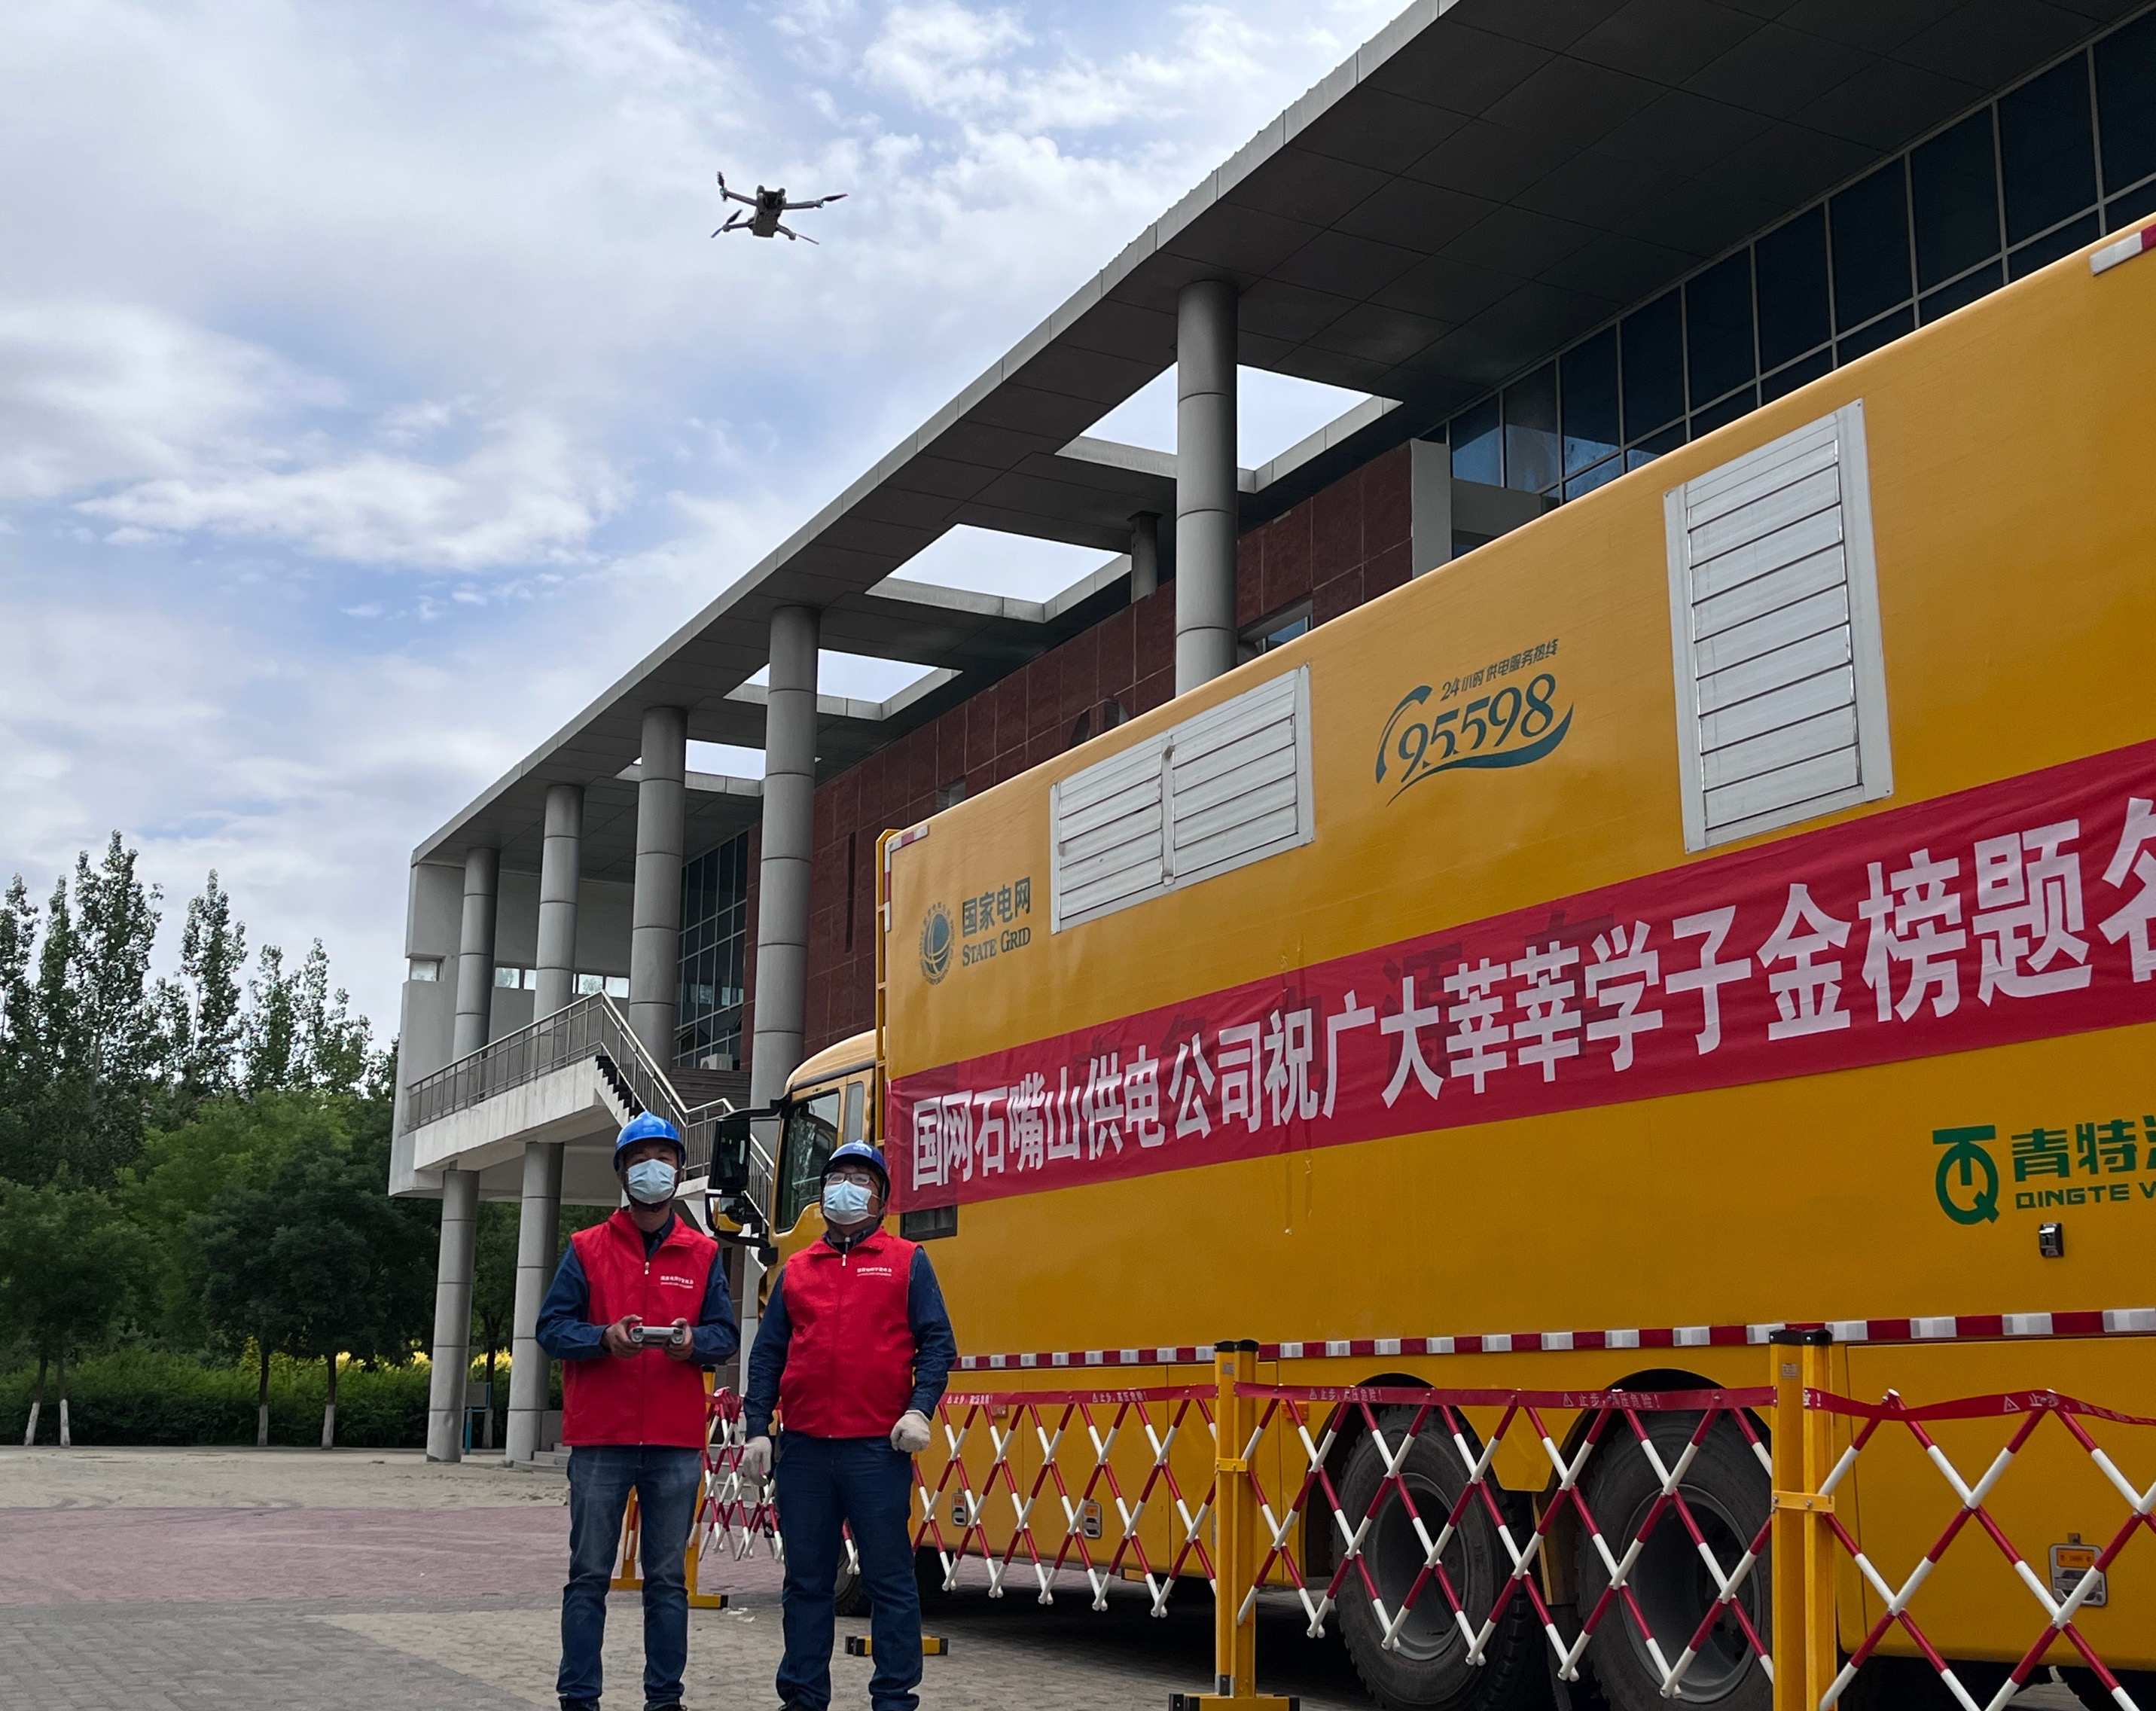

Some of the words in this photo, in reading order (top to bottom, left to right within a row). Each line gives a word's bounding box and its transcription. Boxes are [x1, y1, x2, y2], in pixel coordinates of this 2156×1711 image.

[1398, 673, 1556, 783] 95598
[962, 876, 1031, 938] 国家电网
[962, 940, 997, 967] STATE
[1001, 926, 1031, 953] GRID
[2011, 1115, 2156, 1182] 青特
[2016, 1183, 2130, 1209] QINGTE
